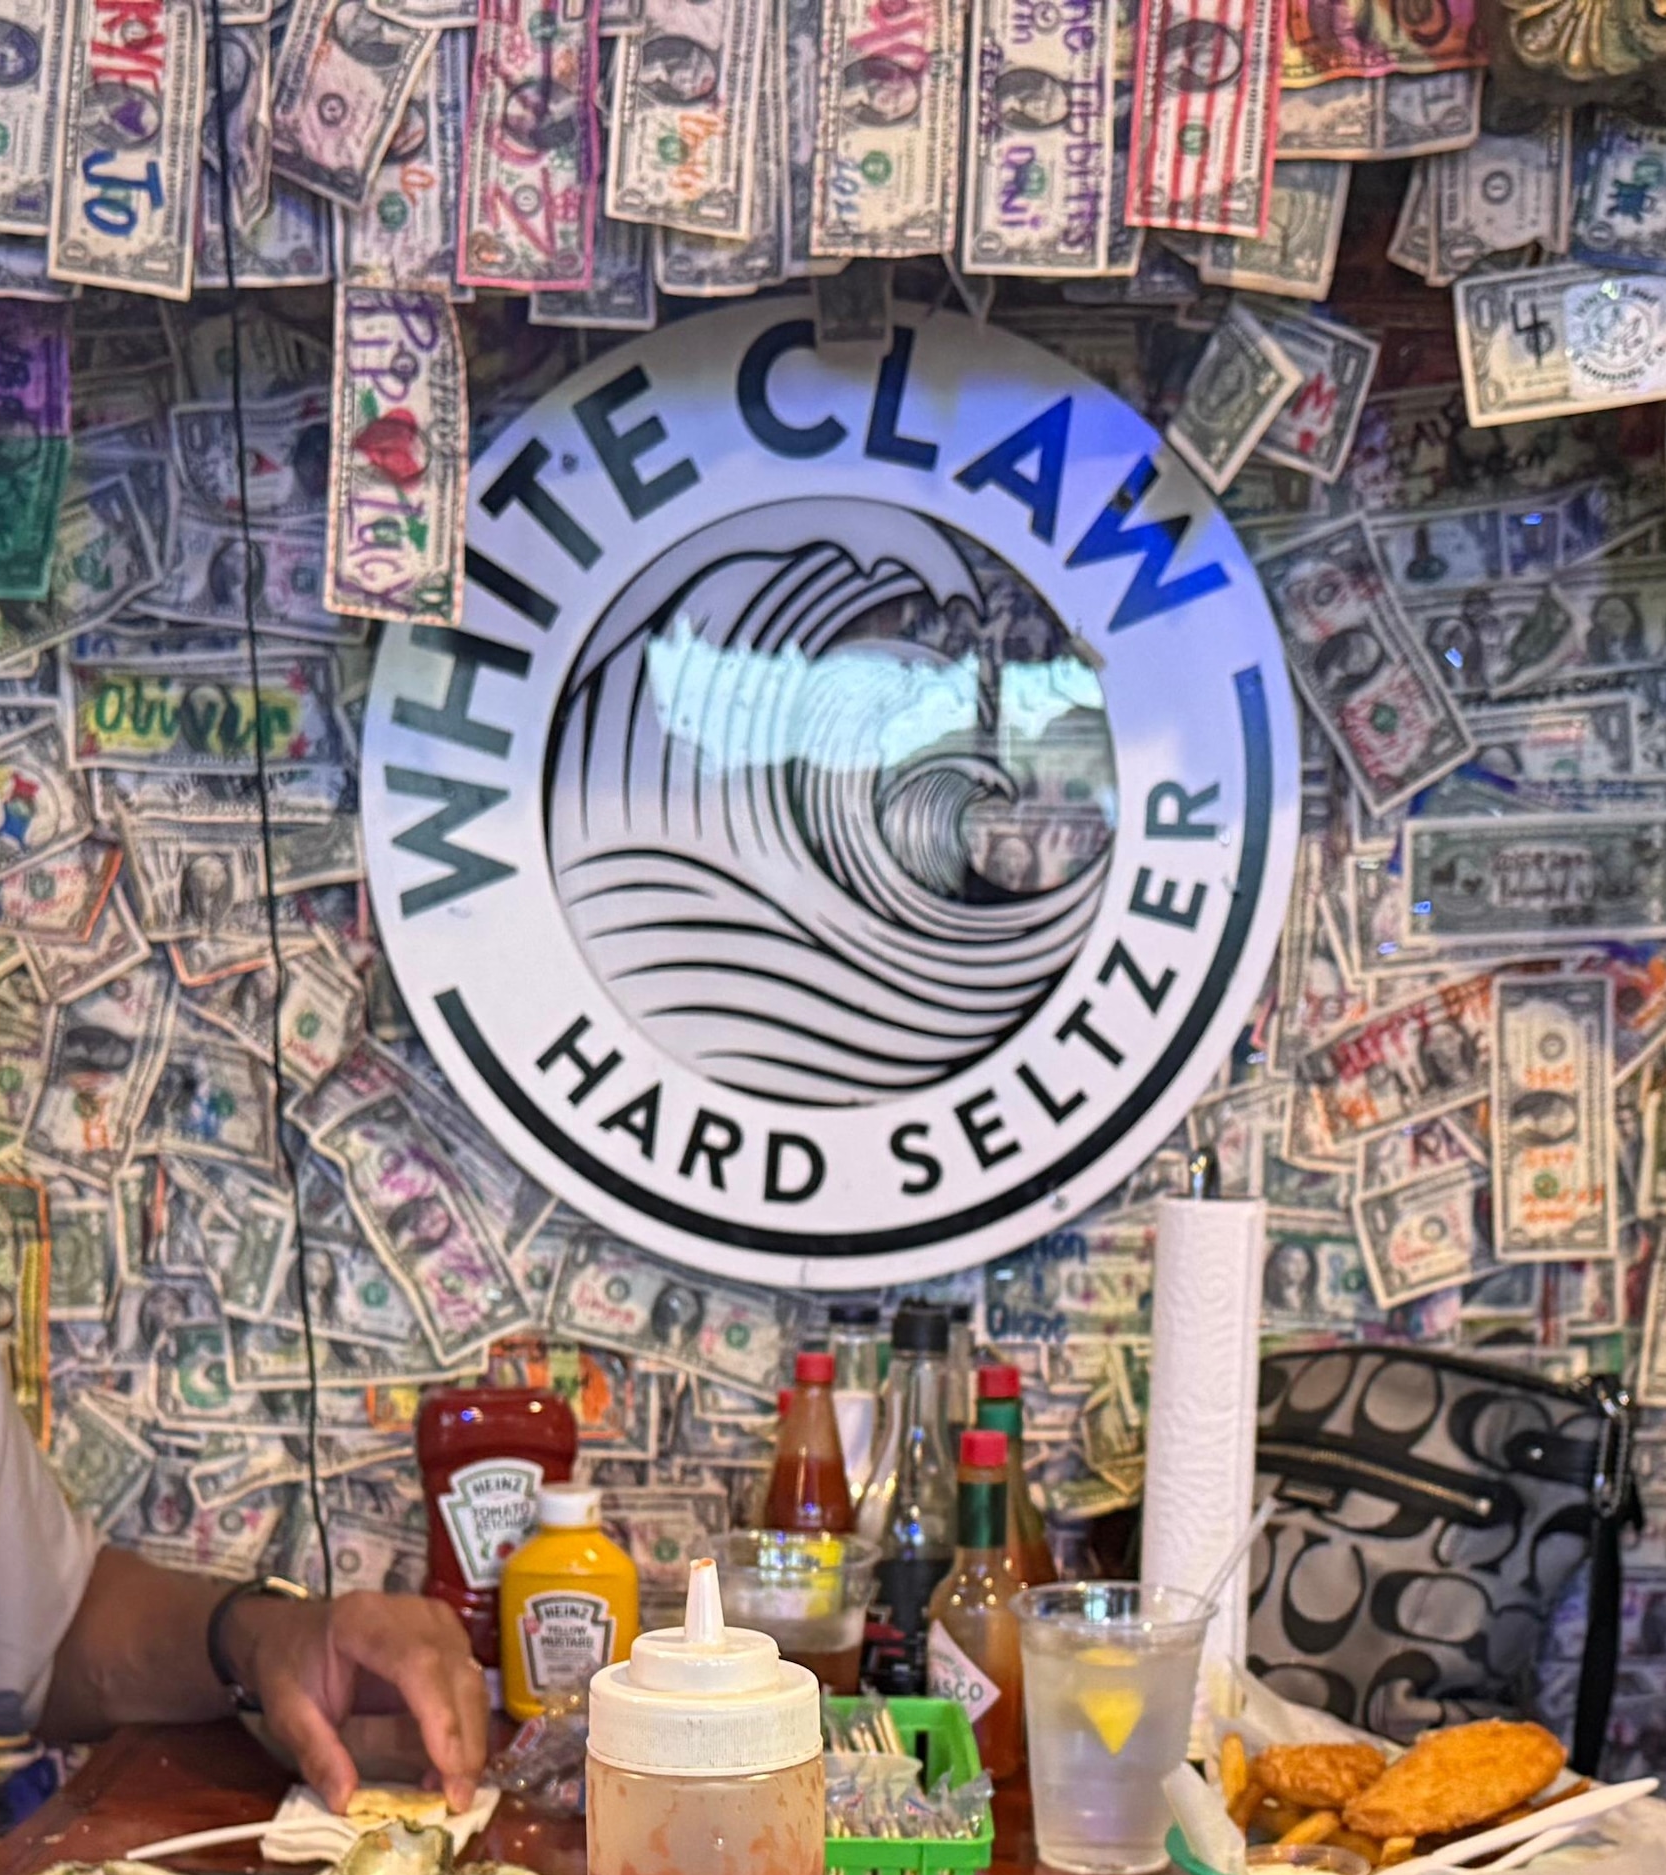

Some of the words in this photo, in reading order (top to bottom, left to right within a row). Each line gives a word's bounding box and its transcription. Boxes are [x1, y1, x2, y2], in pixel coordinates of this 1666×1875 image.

[382, 365, 702, 919] WHITE
[735, 318, 1233, 634] CLAW
[536, 1015, 827, 1205] HARD
[889, 776, 1222, 1196] SELTZER
[471, 1474, 523, 1496] HEINZ
[471, 1501, 532, 1521] TOMATO
[543, 1602, 590, 1621] HEINZ
